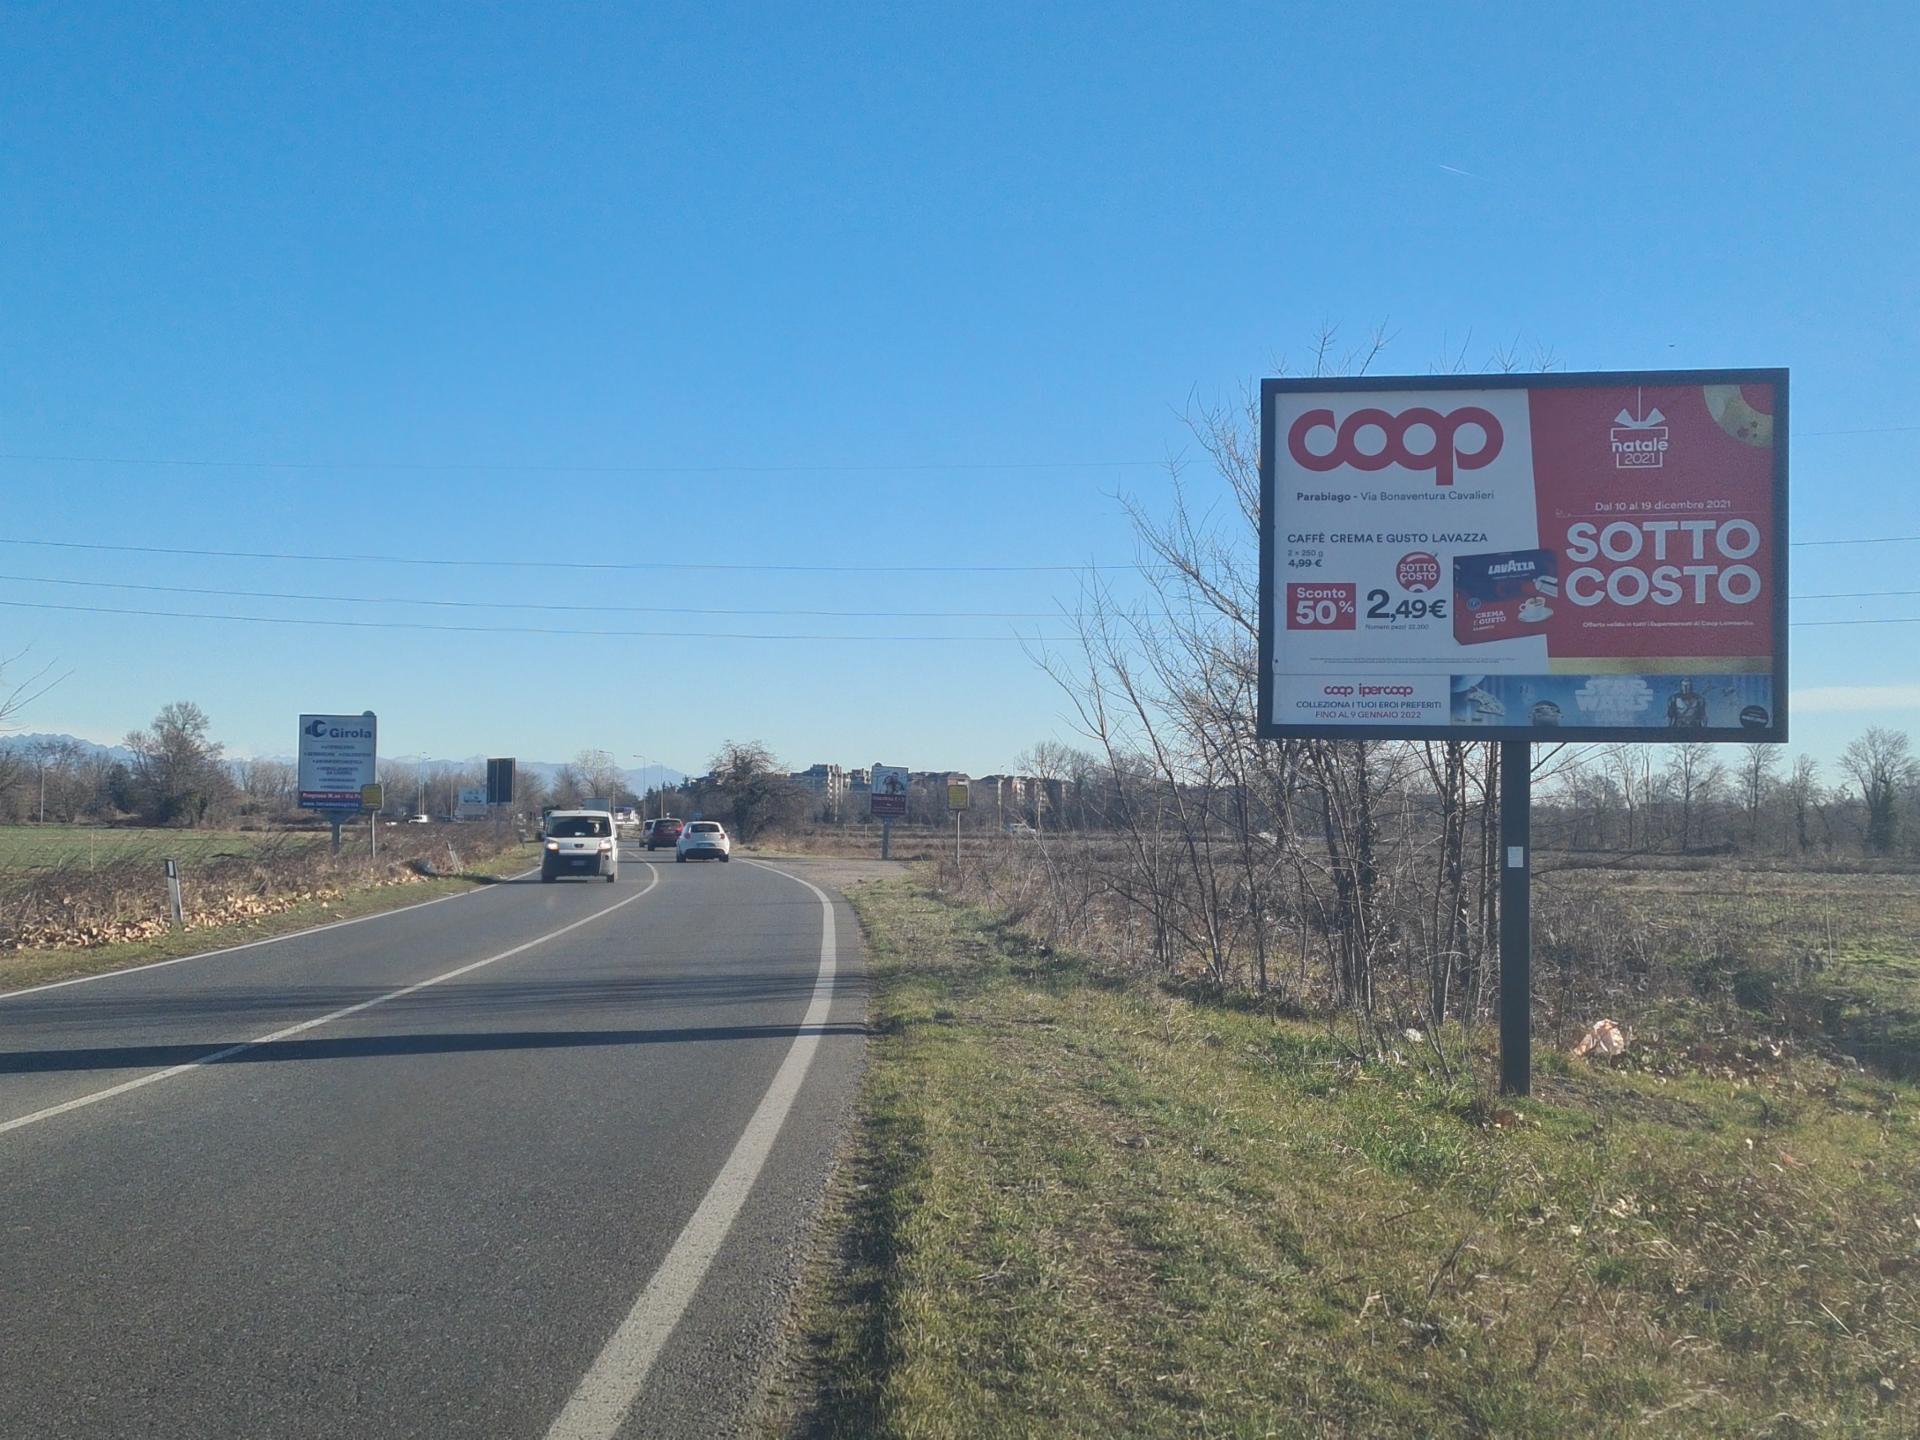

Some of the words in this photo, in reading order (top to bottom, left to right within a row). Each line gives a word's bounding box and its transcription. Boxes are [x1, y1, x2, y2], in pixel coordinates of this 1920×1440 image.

[1288, 407, 1504, 486] coop
[1612, 438, 1668, 452] natale
[1624, 453, 1655, 465] 2021
[1297, 492, 1351, 503] Parabiago
[1360, 492, 1377, 501] Via
[1380, 491, 1446, 501] Bonaventura
[1449, 490, 1494, 500] Cavalieri
[1595, 501, 1612, 511] Dal
[1614, 501, 1627, 511] 10
[1629, 501, 1638, 511] al
[1641, 501, 1651, 510] 19
[1654, 500, 1704, 510] dicembre
[1706, 499, 1731, 509] 2021
[1287, 533, 1325, 544] CAFFÈ
[1330, 533, 1374, 543] CREMA
[1377, 533, 1383, 543] E
[1386, 533, 1428, 543] GUSTO
[1431, 532, 1488, 543] LAVAZZA
[1566, 518, 1761, 562] SOTTO
[1287, 559, 1312, 568] 4,99
[1314, 559, 1322, 568] €
[1399, 563, 1437, 572] SOTTO
[1488, 560, 1536, 575] LAVAZZA
[1399, 572, 1437, 581] COSTO
[1565, 564, 1761, 607] COSTO
[1296, 587, 1347, 598] Sconto
[1366, 589, 1447, 623] 2,49€
[1296, 600, 1355, 625] 50%
[1324, 685, 1354, 697] coop
[1358, 683, 1413, 697] ipercoop
[1296, 701, 1351, 709] COLLEZIONA
[1356, 701, 1377, 709] TUOI
[1379, 701, 1399, 709] EROI
[1401, 701, 1442, 709] PREFERITI
[1315, 711, 1336, 719] FINO
[1338, 711, 1349, 719] AL
[1350, 711, 1356, 719] 9
[1357, 711, 1399, 719] GENNAIO
[1400, 711, 1421, 719] 2022
[329, 727, 372, 738] Girola
